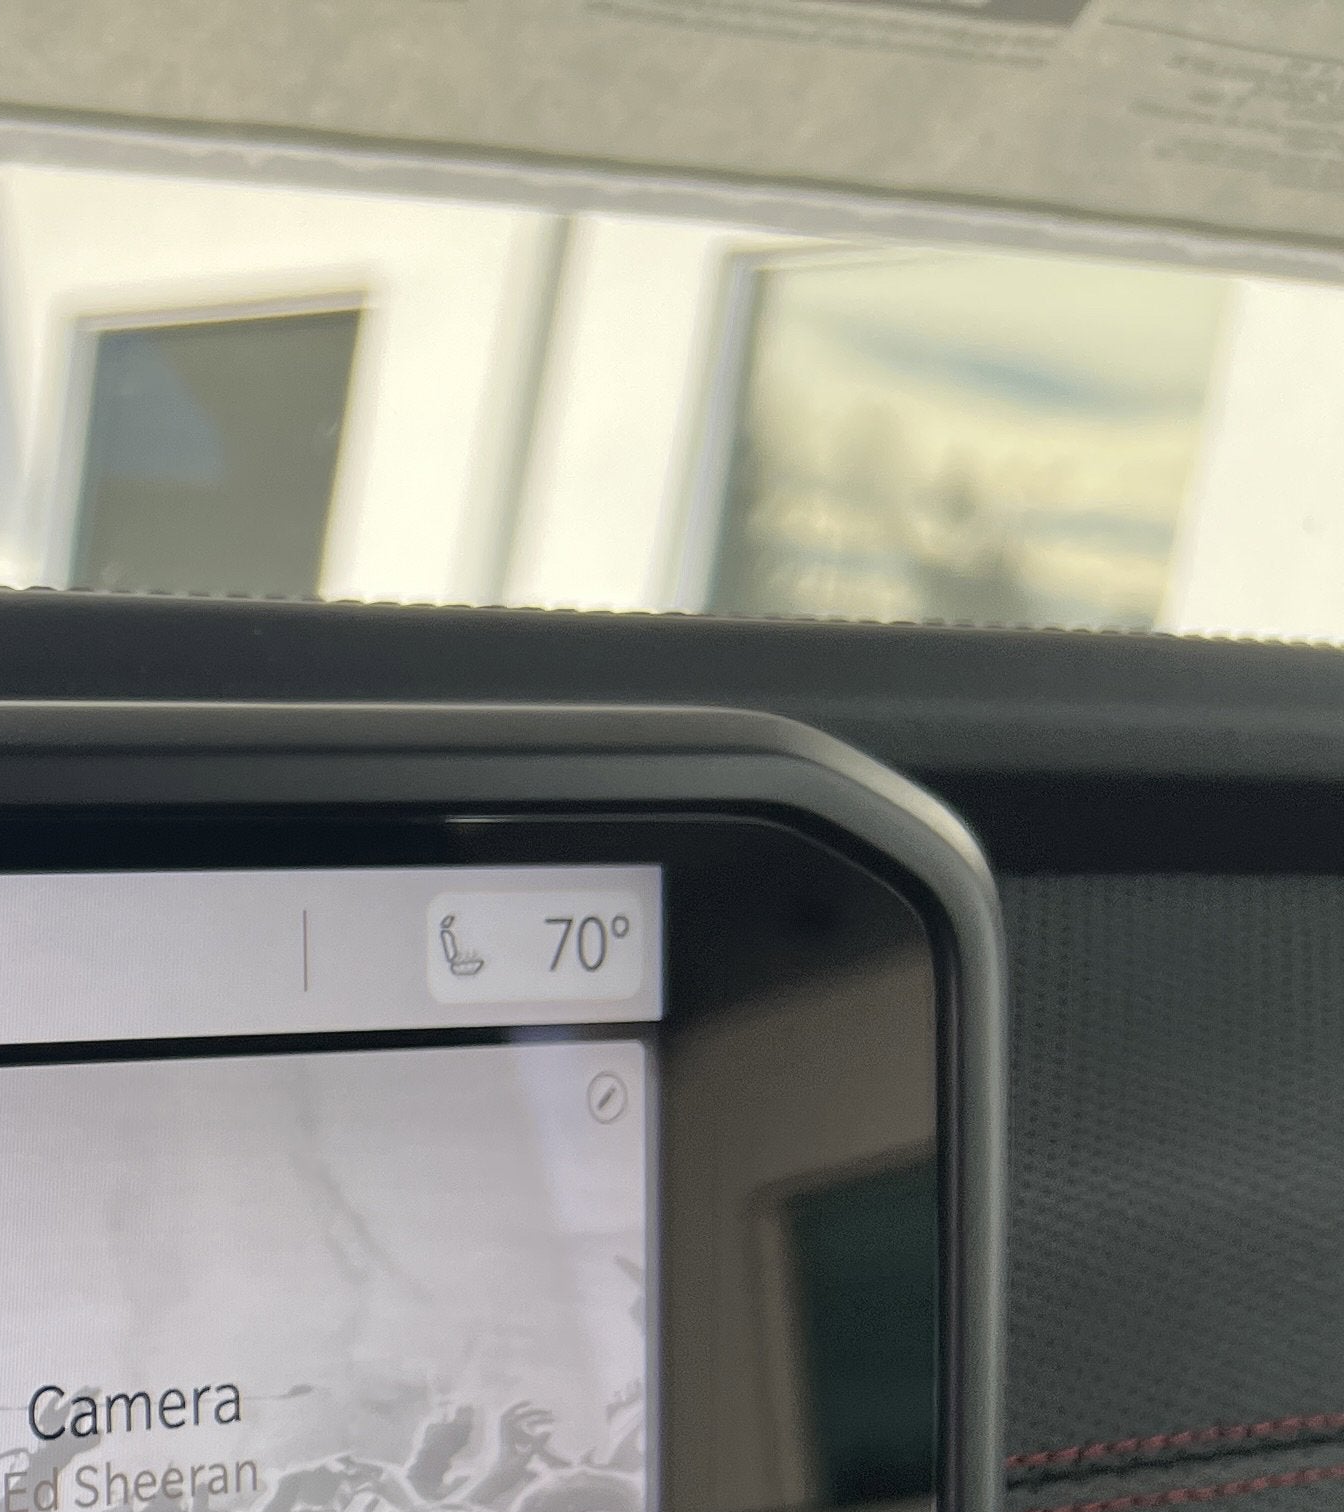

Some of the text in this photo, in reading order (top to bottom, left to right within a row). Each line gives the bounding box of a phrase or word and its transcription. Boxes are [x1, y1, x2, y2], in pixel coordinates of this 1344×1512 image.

[543, 914, 630, 972] 70°
[27, 1382, 243, 1441] Camera
[73, 1456, 259, 1510] Sheeran
